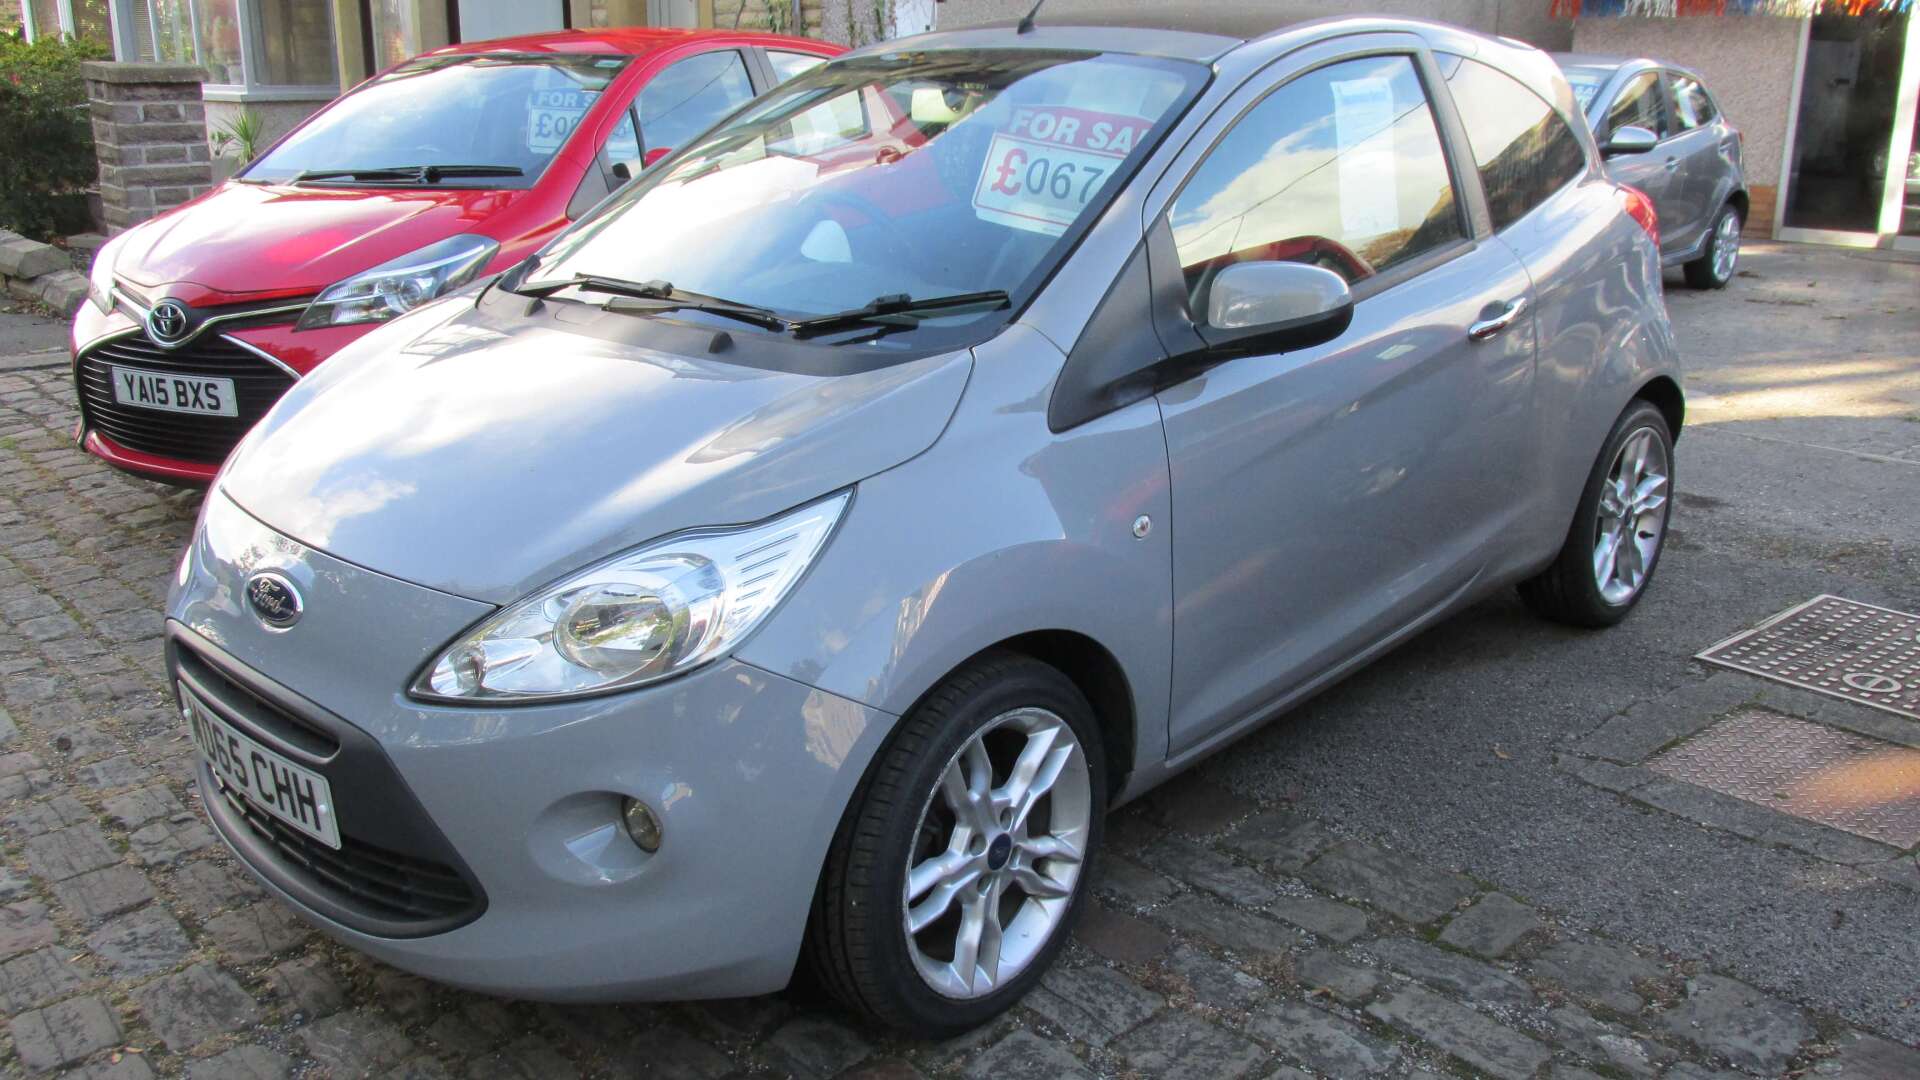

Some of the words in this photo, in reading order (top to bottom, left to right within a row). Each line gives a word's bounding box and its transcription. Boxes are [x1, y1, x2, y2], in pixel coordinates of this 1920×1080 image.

[539, 91, 577, 107] FOR
[1008, 109, 1081, 145] FOR
[124, 373, 169, 405] YA15
[172, 379, 221, 411] BXS
[251, 750, 321, 831] CHH
